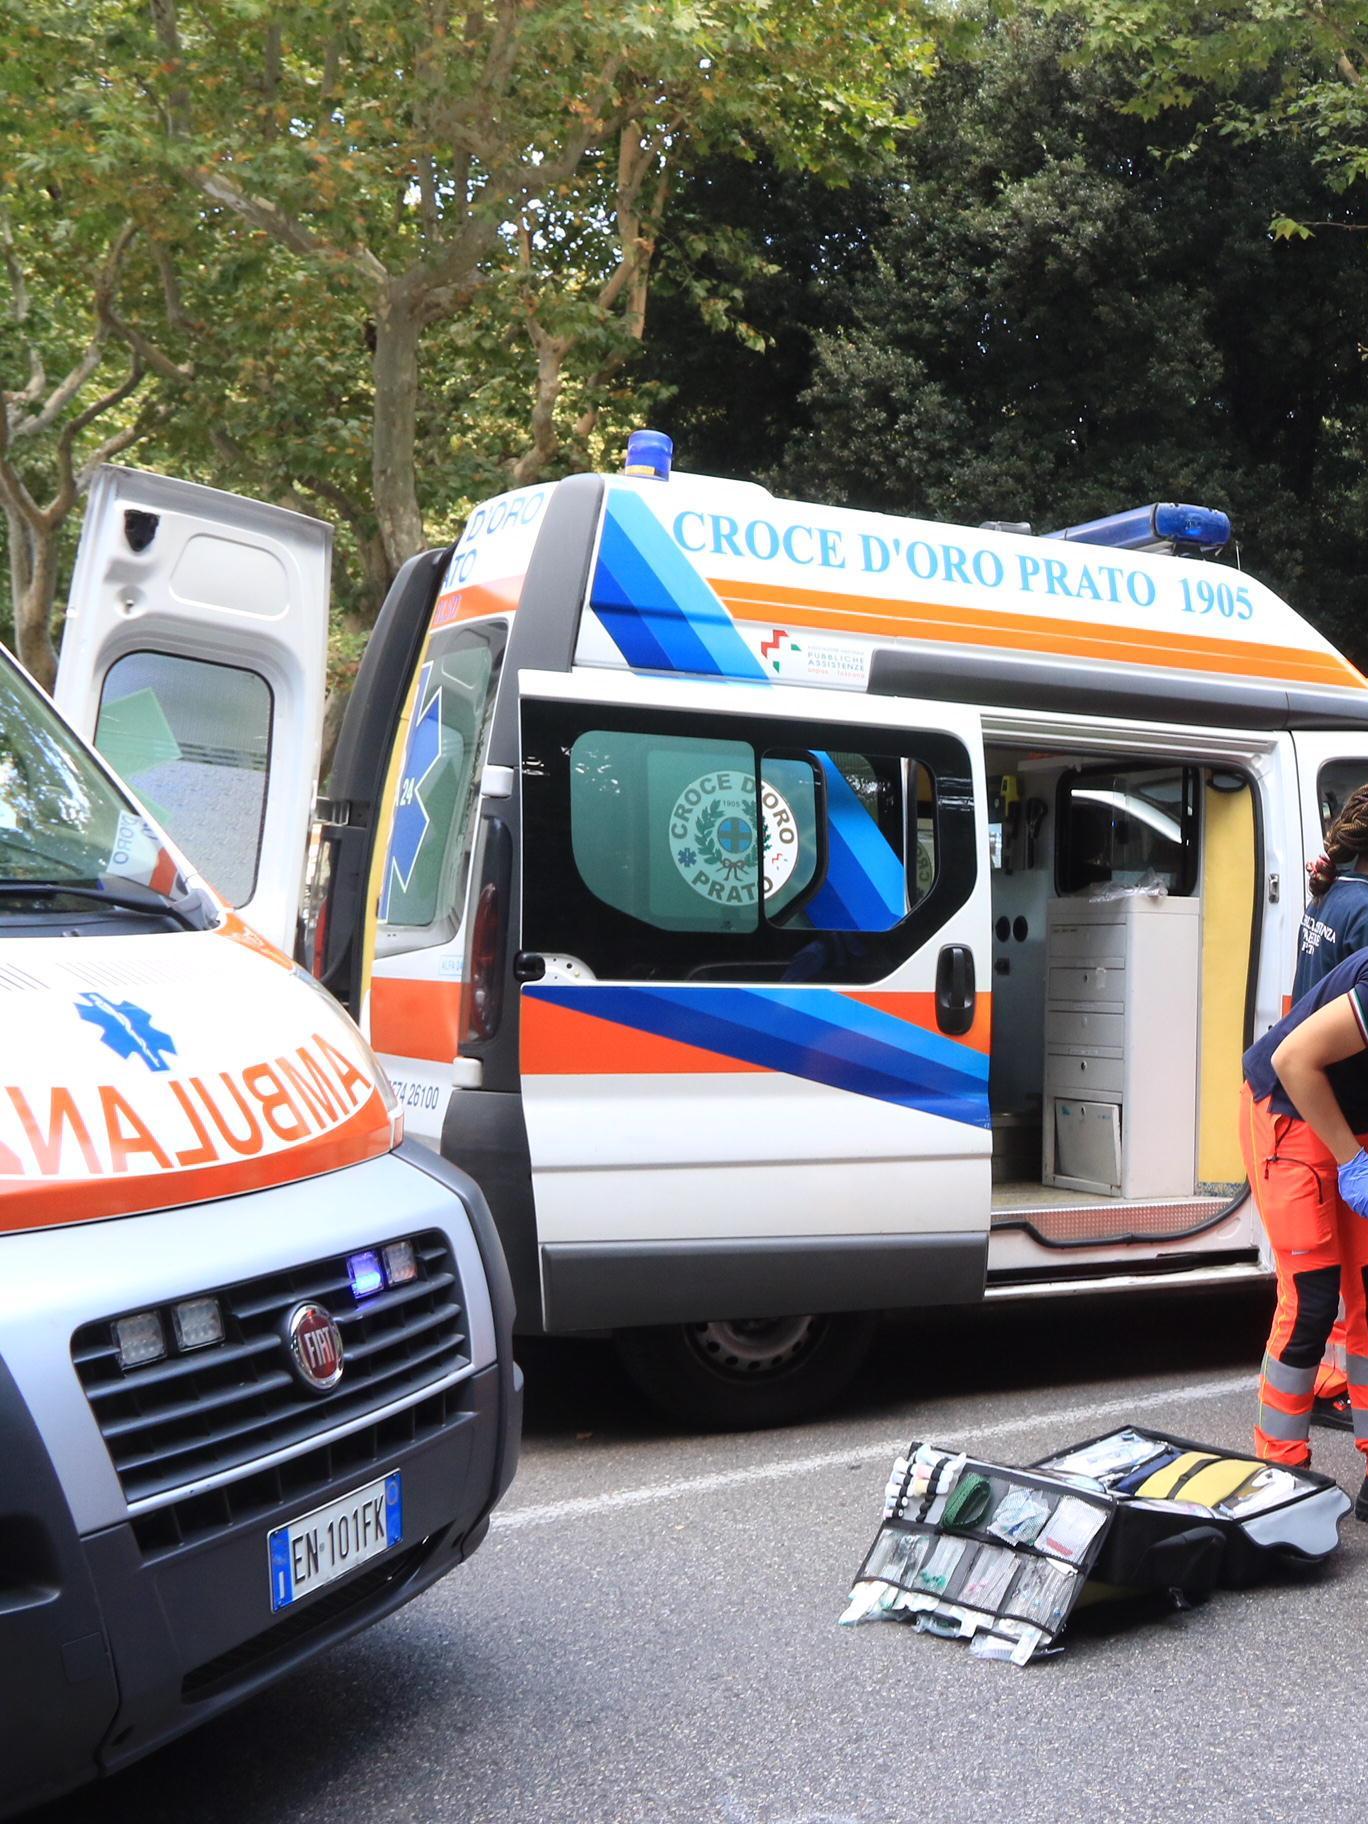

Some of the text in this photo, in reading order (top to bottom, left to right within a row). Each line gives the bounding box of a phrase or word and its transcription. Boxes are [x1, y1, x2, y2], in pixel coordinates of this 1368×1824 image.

[672, 510, 1255, 621] CROCE D'ORO PRATO 1905
[670, 772, 733, 841] CROCE
[406, 1083, 440, 1110] 26100
[303, 1326, 336, 1370] FIAT
[291, 1527, 320, 1586] EN
[326, 1494, 386, 1567] 101FK
